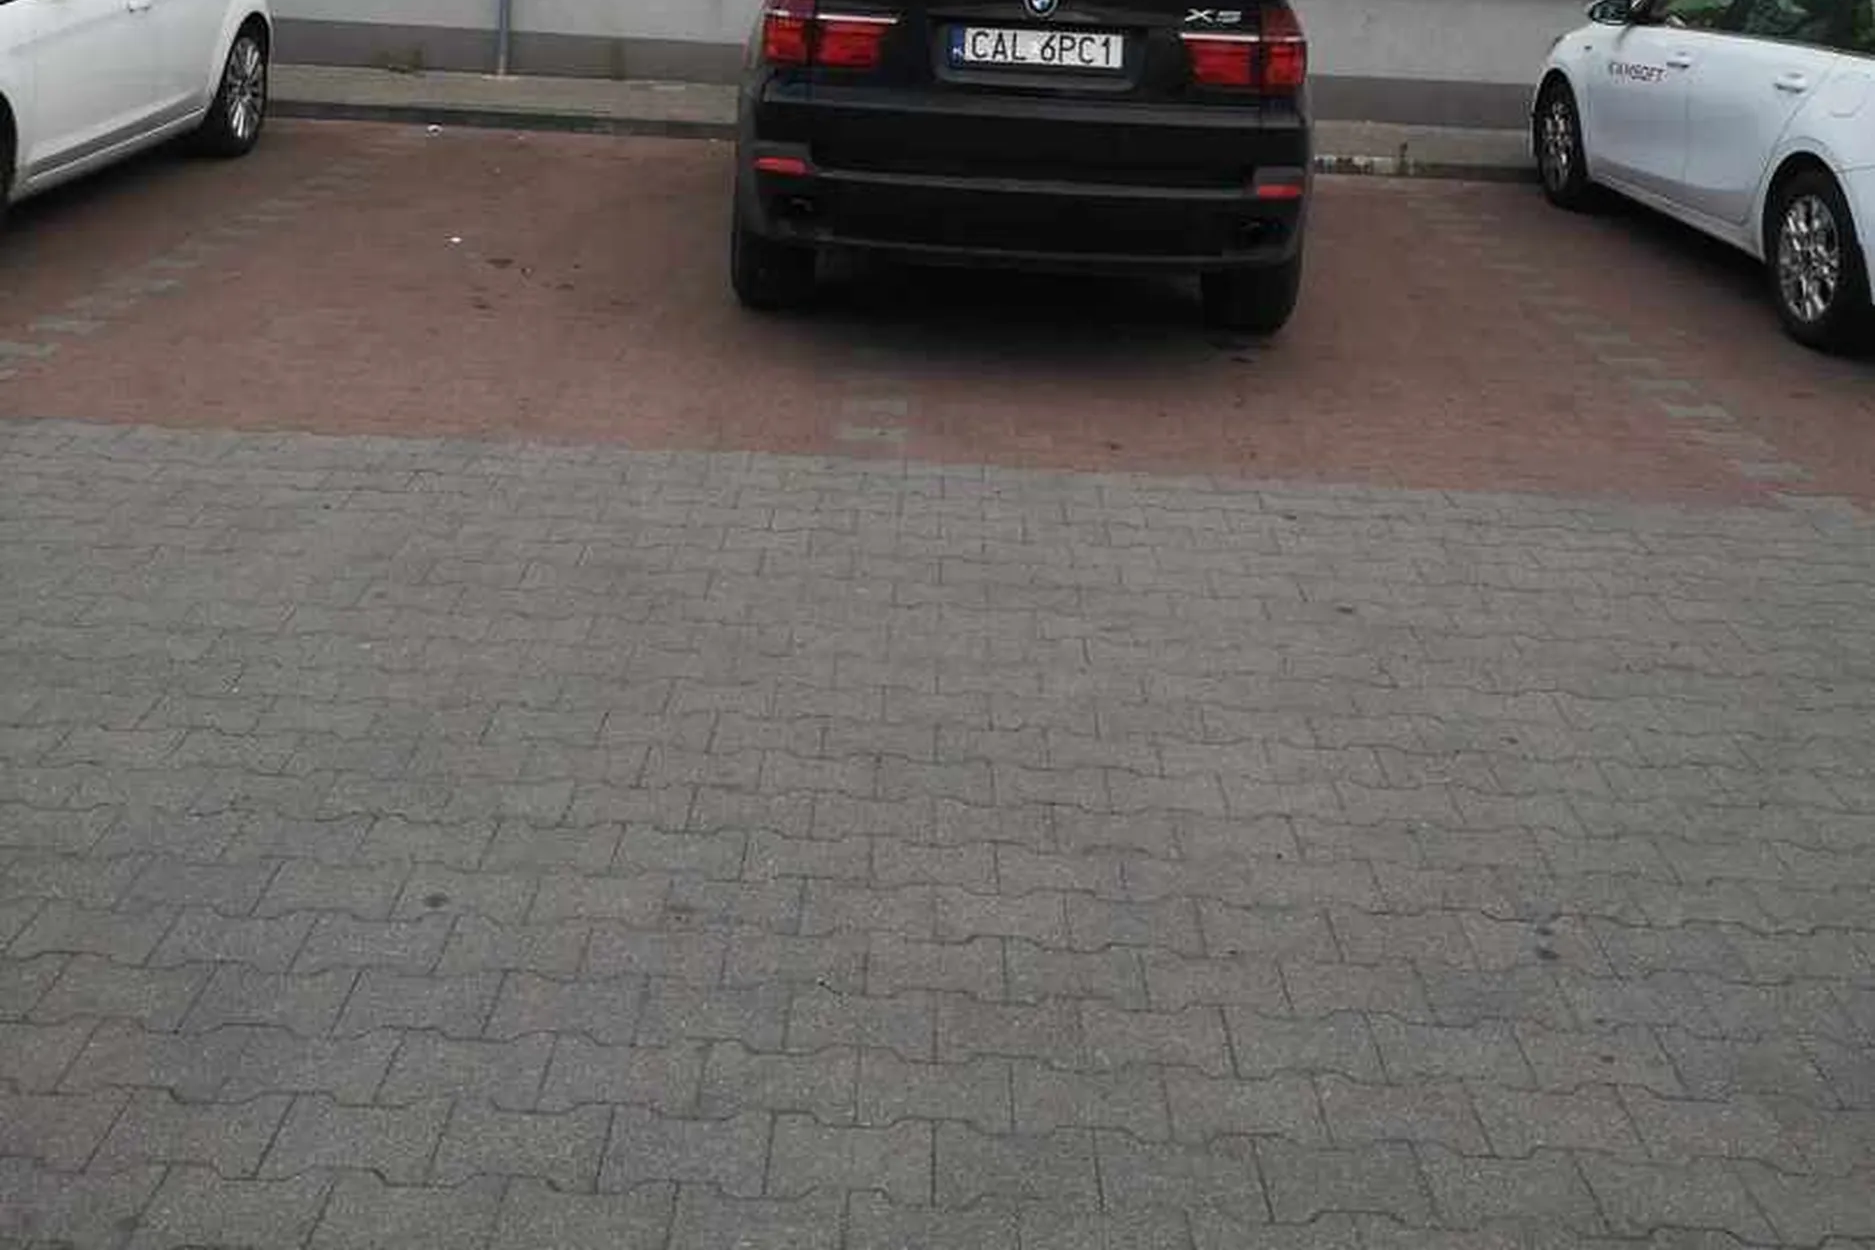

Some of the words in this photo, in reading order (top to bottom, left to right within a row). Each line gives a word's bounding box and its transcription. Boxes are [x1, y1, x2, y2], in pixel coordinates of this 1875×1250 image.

[1184, 8, 1242, 24] X5
[972, 31, 1027, 61] CAL
[1040, 34, 1111, 66] 6PC1
